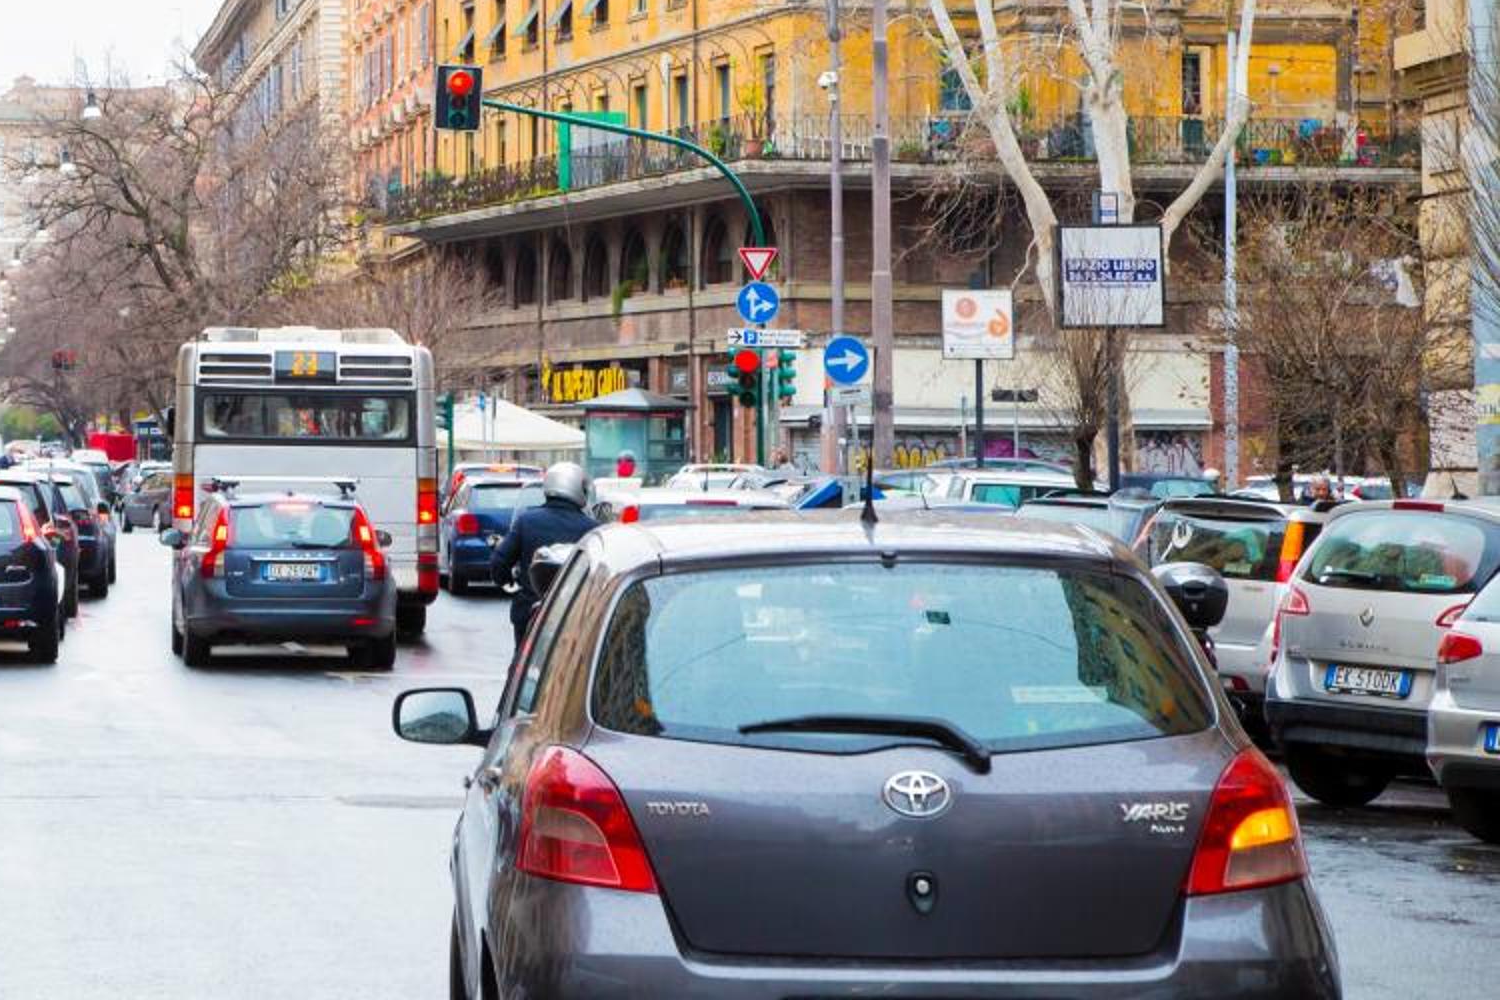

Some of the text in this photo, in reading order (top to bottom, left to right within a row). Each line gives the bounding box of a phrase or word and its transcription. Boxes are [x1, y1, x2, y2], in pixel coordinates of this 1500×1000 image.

[1113, 260, 1155, 271] LIBERO
[646, 801, 710, 816] TOYOTA
[1120, 802, 1189, 821] YARIS
